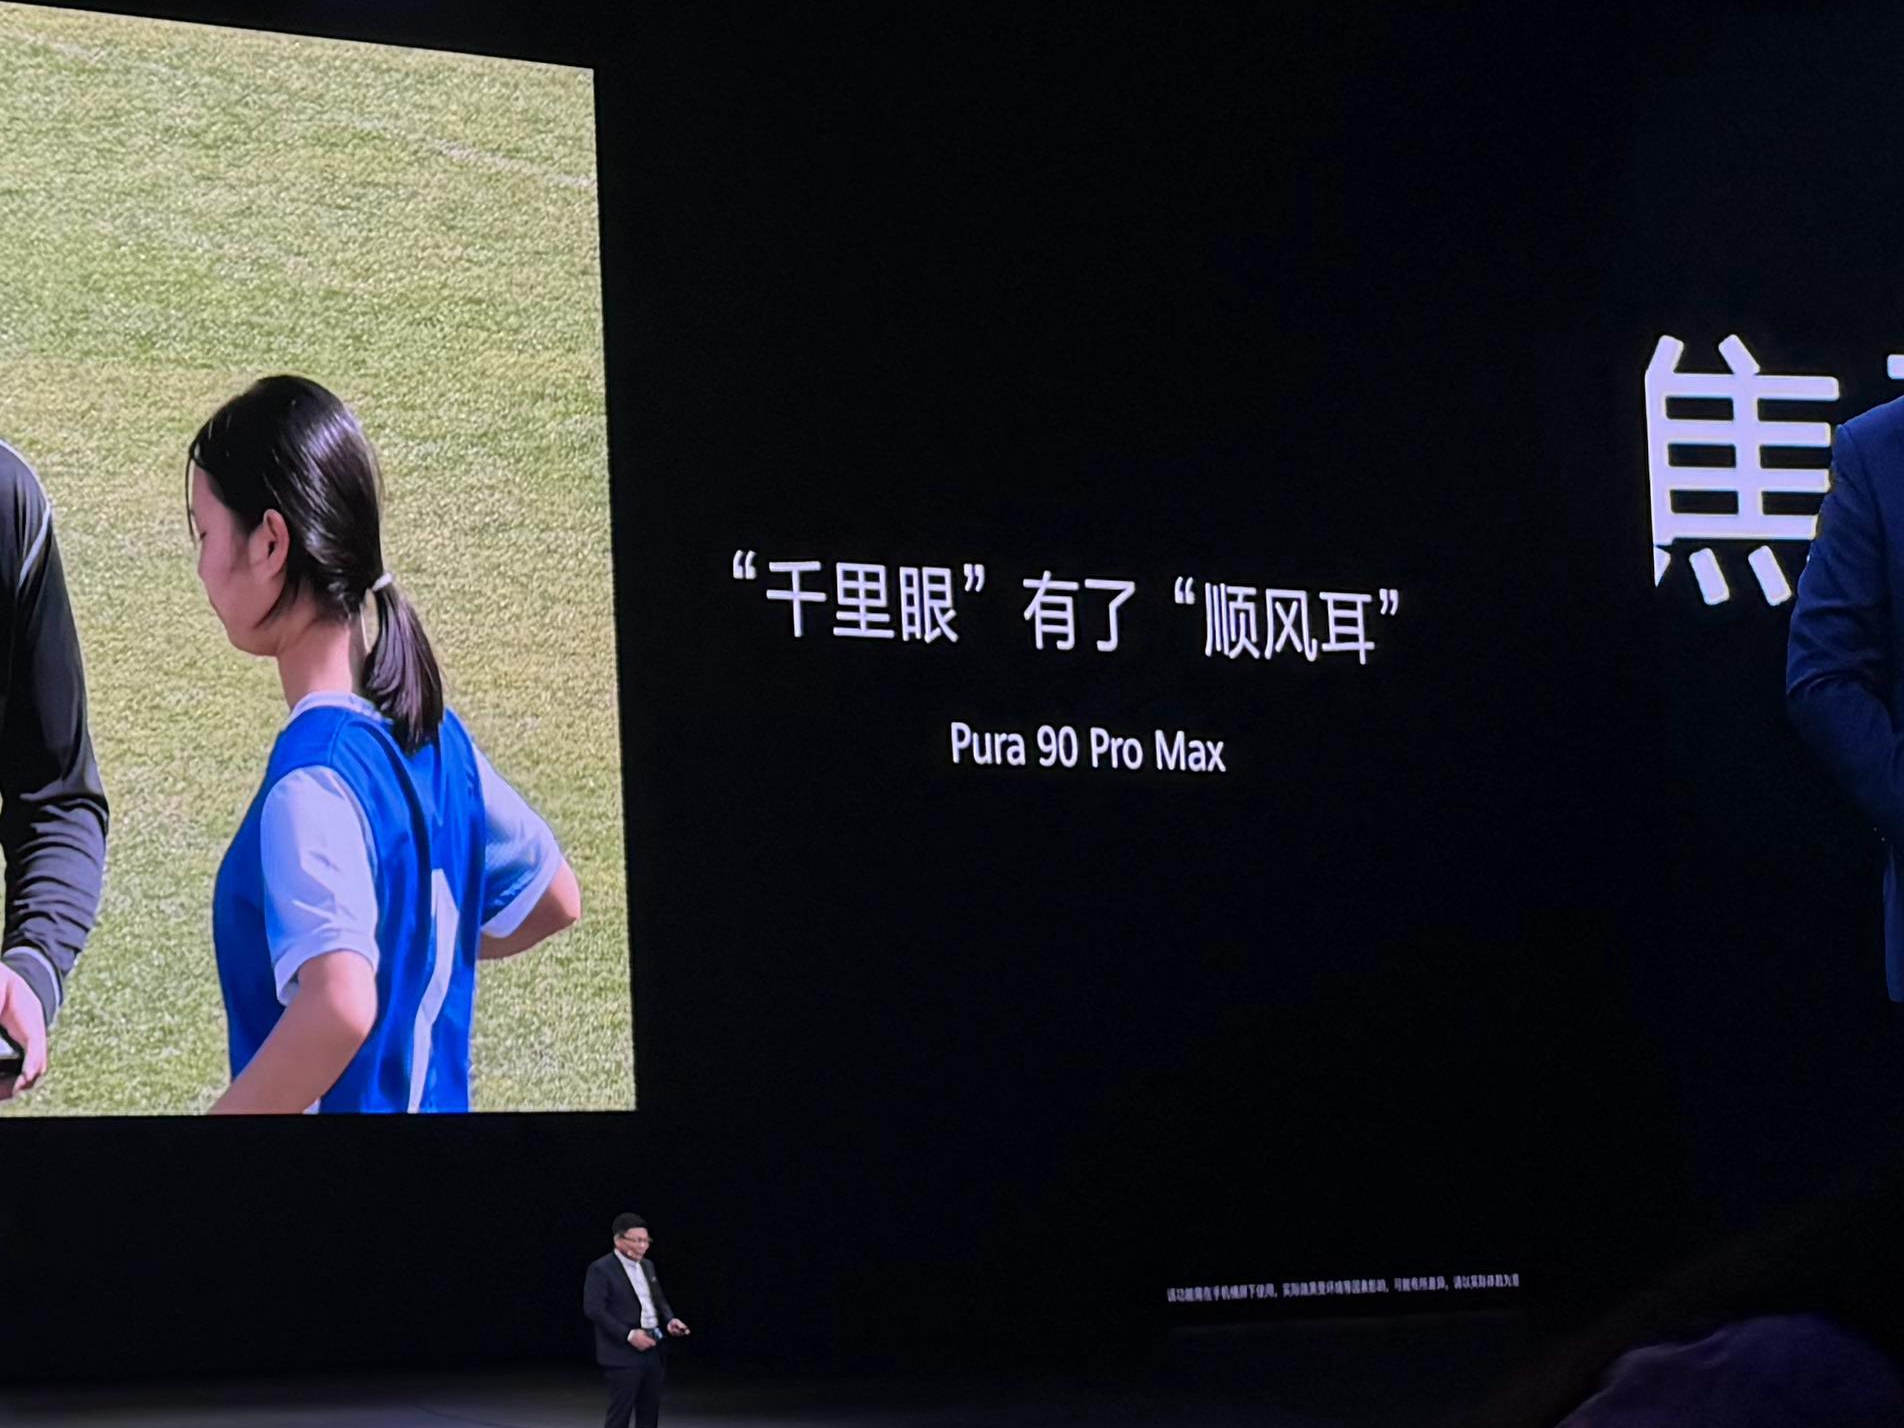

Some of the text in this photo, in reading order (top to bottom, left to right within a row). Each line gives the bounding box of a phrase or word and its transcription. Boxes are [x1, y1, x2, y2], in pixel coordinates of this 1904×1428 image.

[950, 721, 1227, 773] Pura 90 Pro Max
